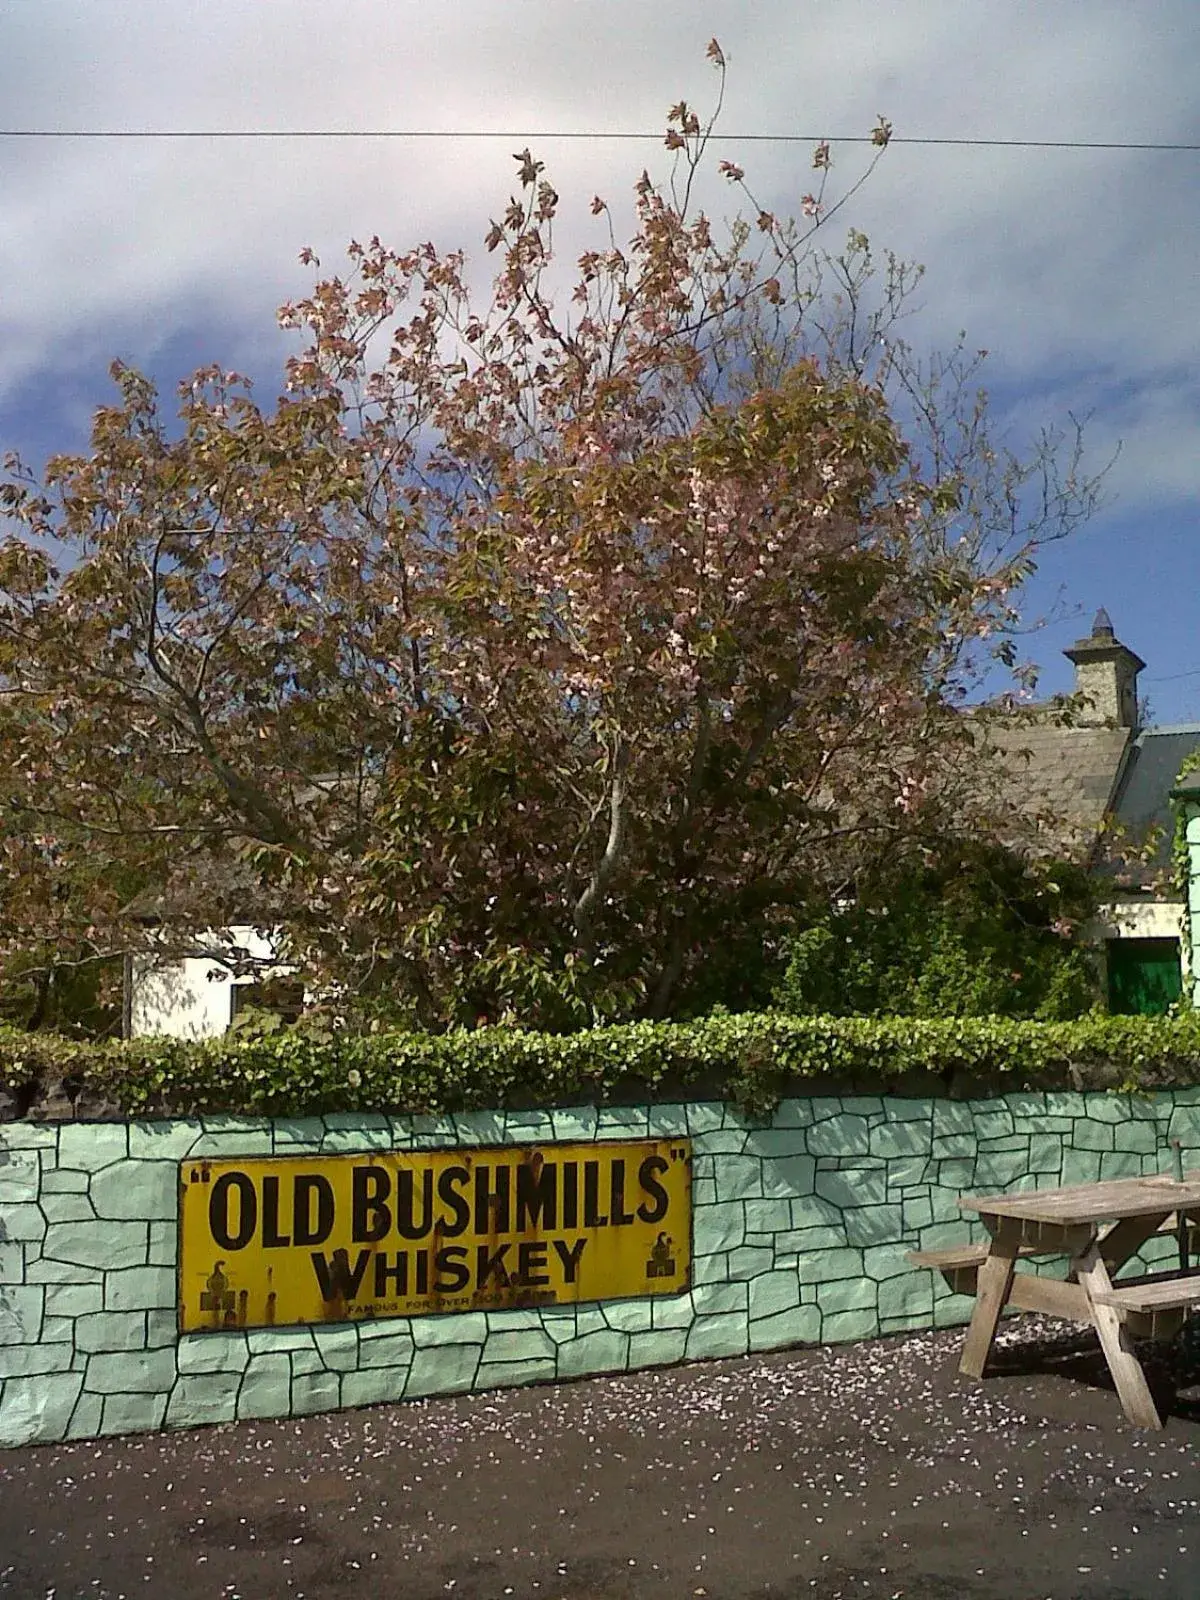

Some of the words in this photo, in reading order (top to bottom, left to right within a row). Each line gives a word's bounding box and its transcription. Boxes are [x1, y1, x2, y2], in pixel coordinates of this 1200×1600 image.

[311, 1238, 588, 1302] WHISKEY
[347, 1302, 399, 1315] FAMOUS
[406, 1300, 432, 1310] FOR
[439, 1297, 470, 1308] OVER
